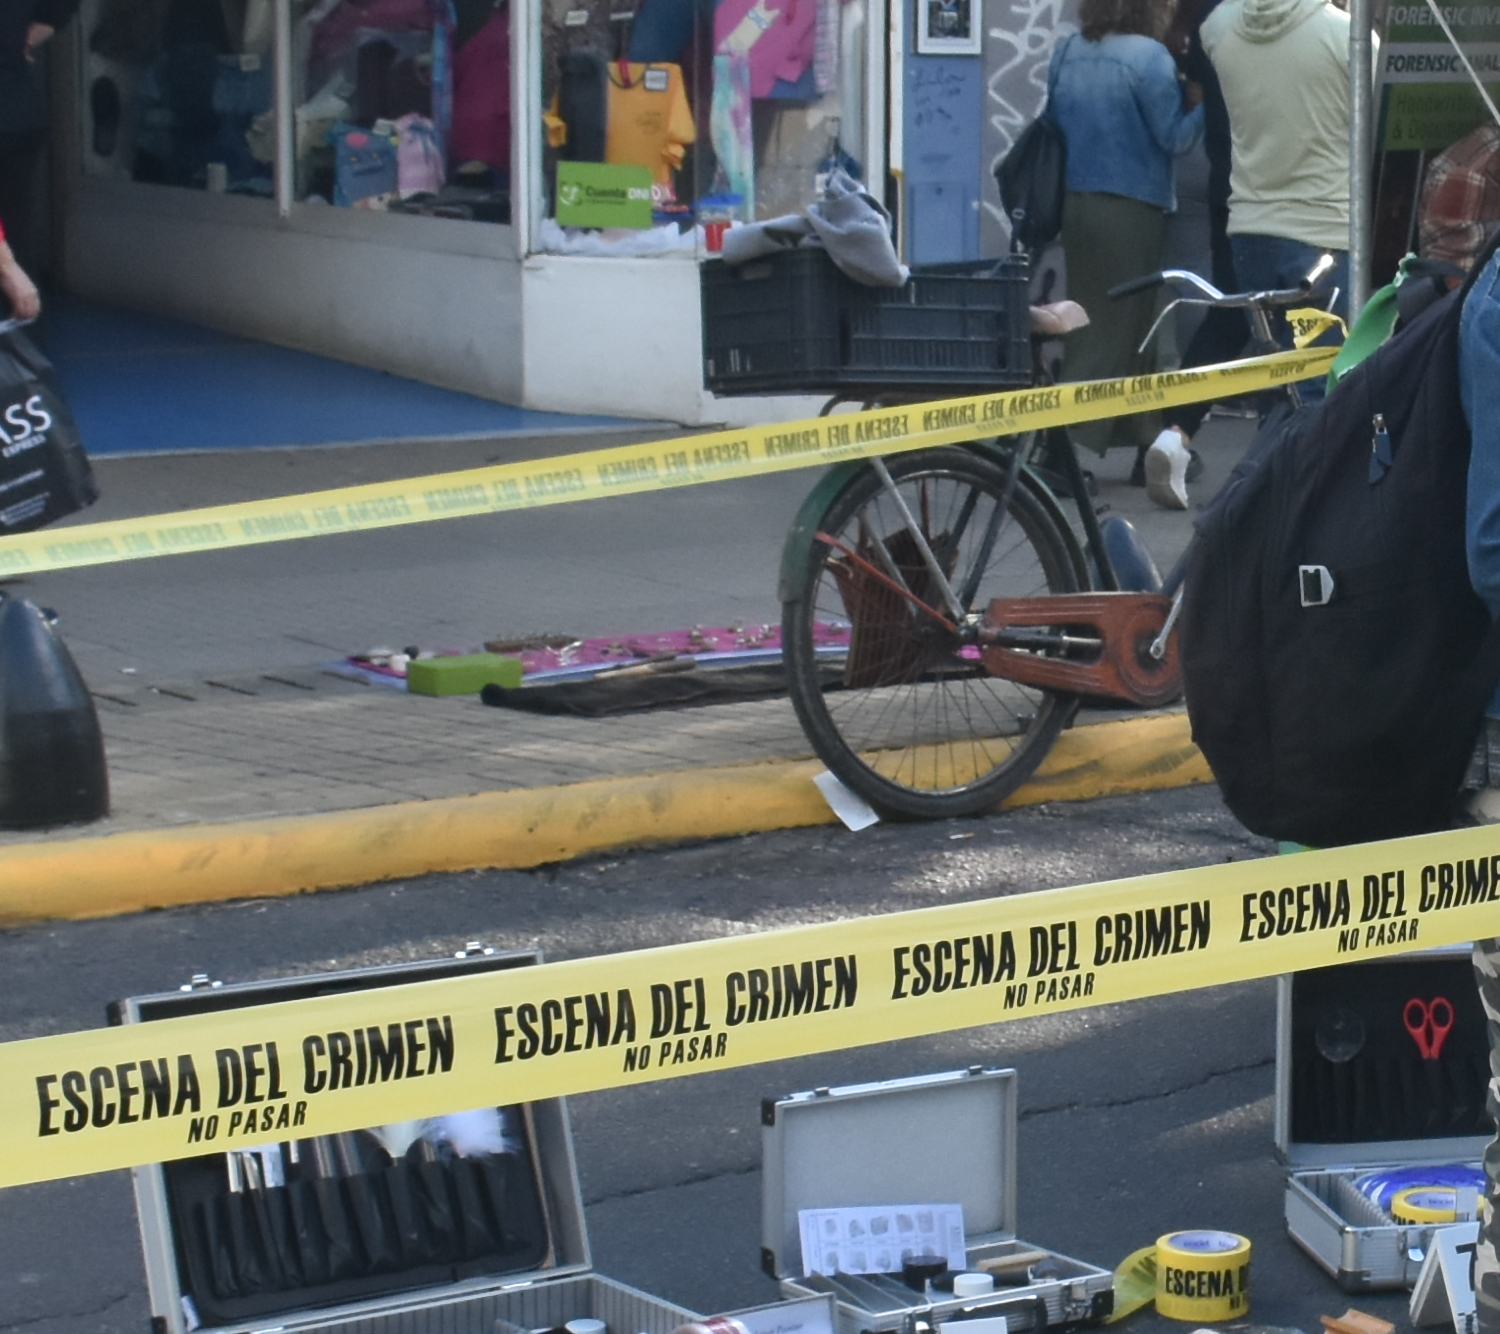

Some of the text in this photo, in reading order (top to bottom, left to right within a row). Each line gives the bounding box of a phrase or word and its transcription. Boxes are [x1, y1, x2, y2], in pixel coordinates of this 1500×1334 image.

[1386, 5, 1468, 26] FORENSIC
[1386, 55, 1459, 74] FORENSIC
[586, 186, 626, 199] Cuenta
[1239, 875, 1350, 942] ESCENA
[1361, 871, 1407, 919] DEL
[891, 899, 1212, 1001] ESCENA DEL CRIMEN
[1337, 918, 1419, 953] NO PASAR
[494, 953, 859, 1065] ESCENA DEL CRIMEN
[1003, 974, 1096, 1011] NO PASAR
[623, 1031, 728, 1074] NO PASAR
[37, 1014, 456, 1139] ESCENA DEL CRIMEN
[185, 1099, 309, 1147] NO PASAR
[1166, 1266, 1234, 1298] ESCENA
